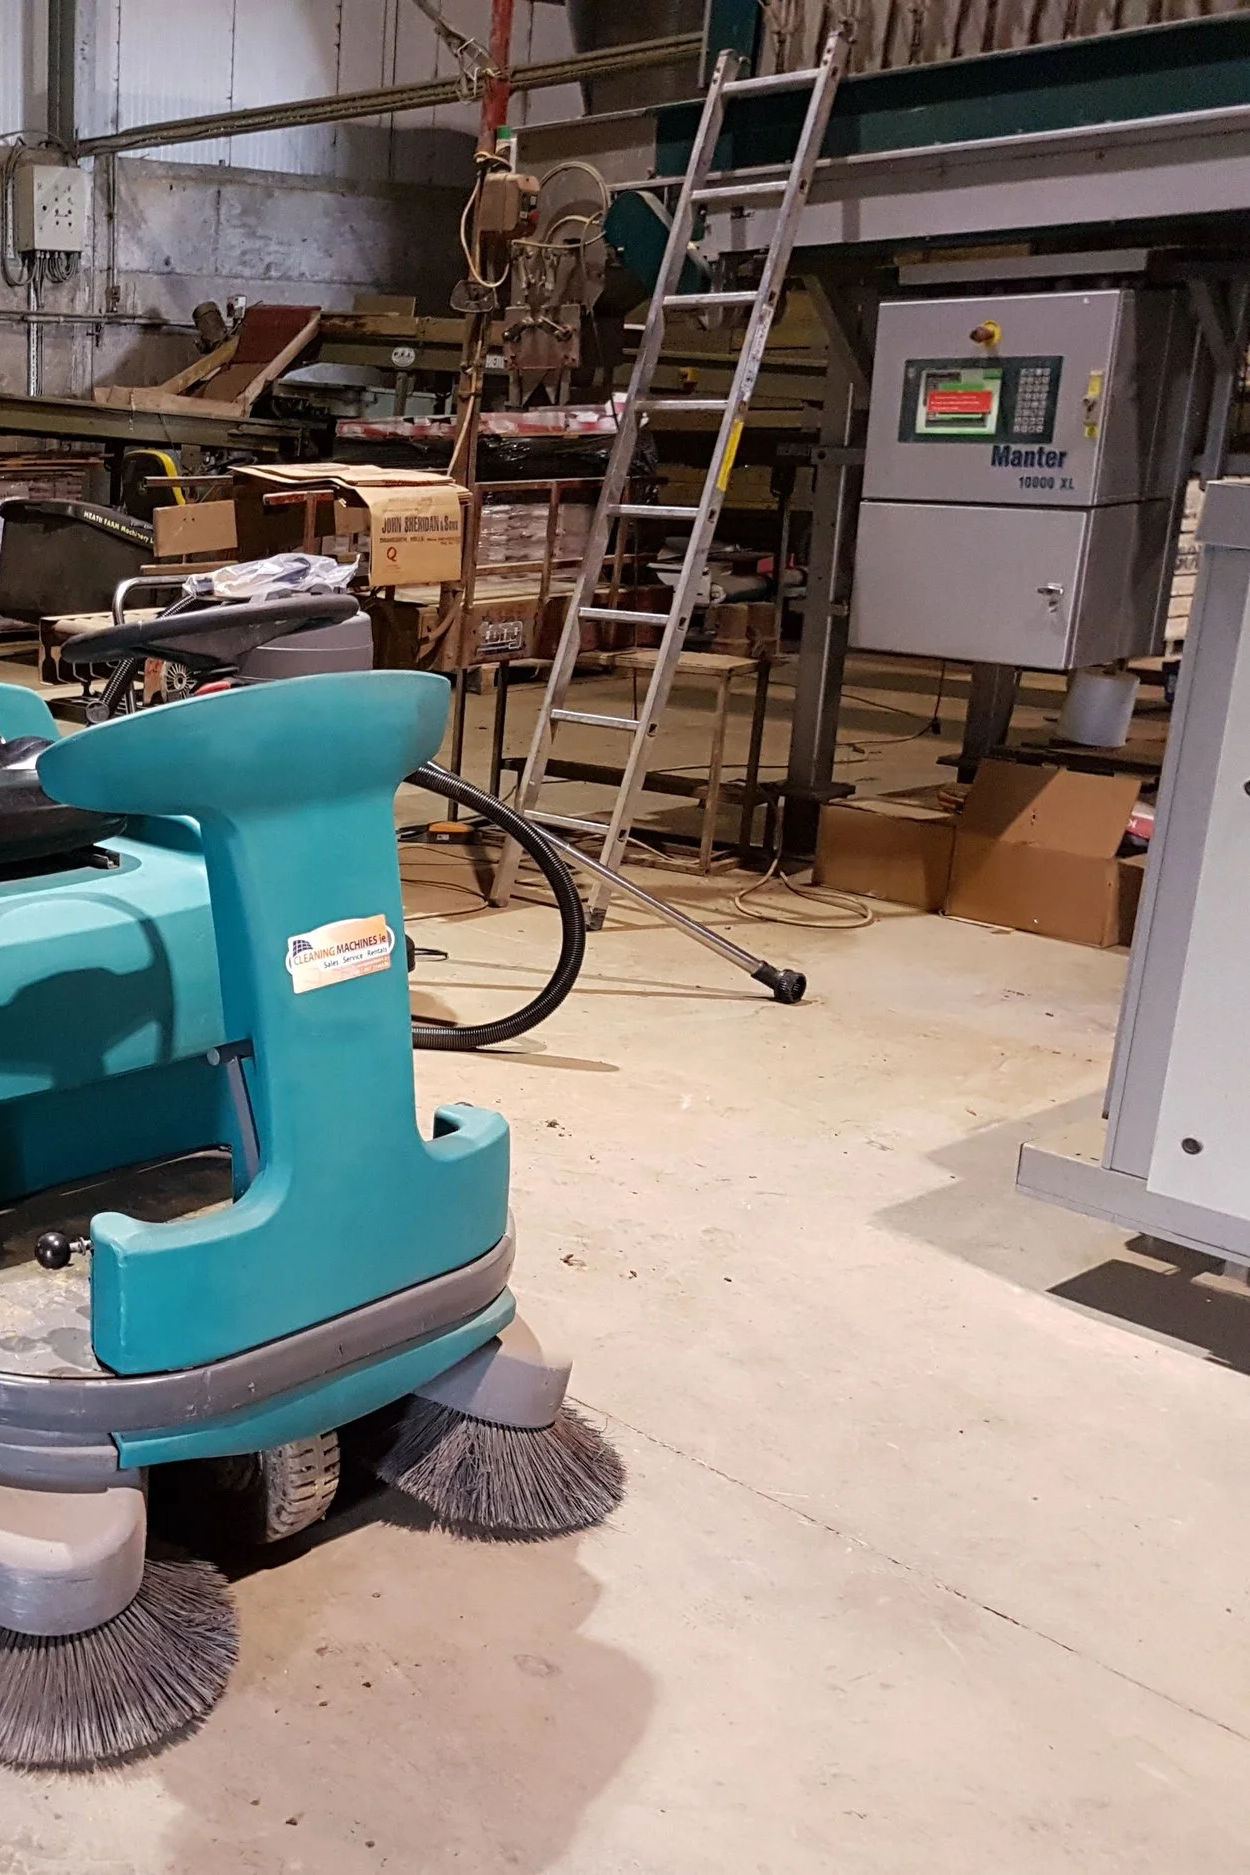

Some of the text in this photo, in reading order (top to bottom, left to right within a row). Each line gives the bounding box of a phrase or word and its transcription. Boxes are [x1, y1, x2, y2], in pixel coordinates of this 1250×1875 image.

[990, 445, 1069, 468] Manter
[1018, 476, 1075, 490] 10000 XL
[382, 516, 402, 533] JOHN
[404, 515, 439, 533] SHERIDAN
[387, 546, 398, 562] Q
[293, 946, 336, 966] CLEANING
[336, 935, 378, 955] MACHINES
[323, 960, 339, 969] Sales
[342, 953, 364, 964] Service
[367, 947, 388, 956] Rentals
